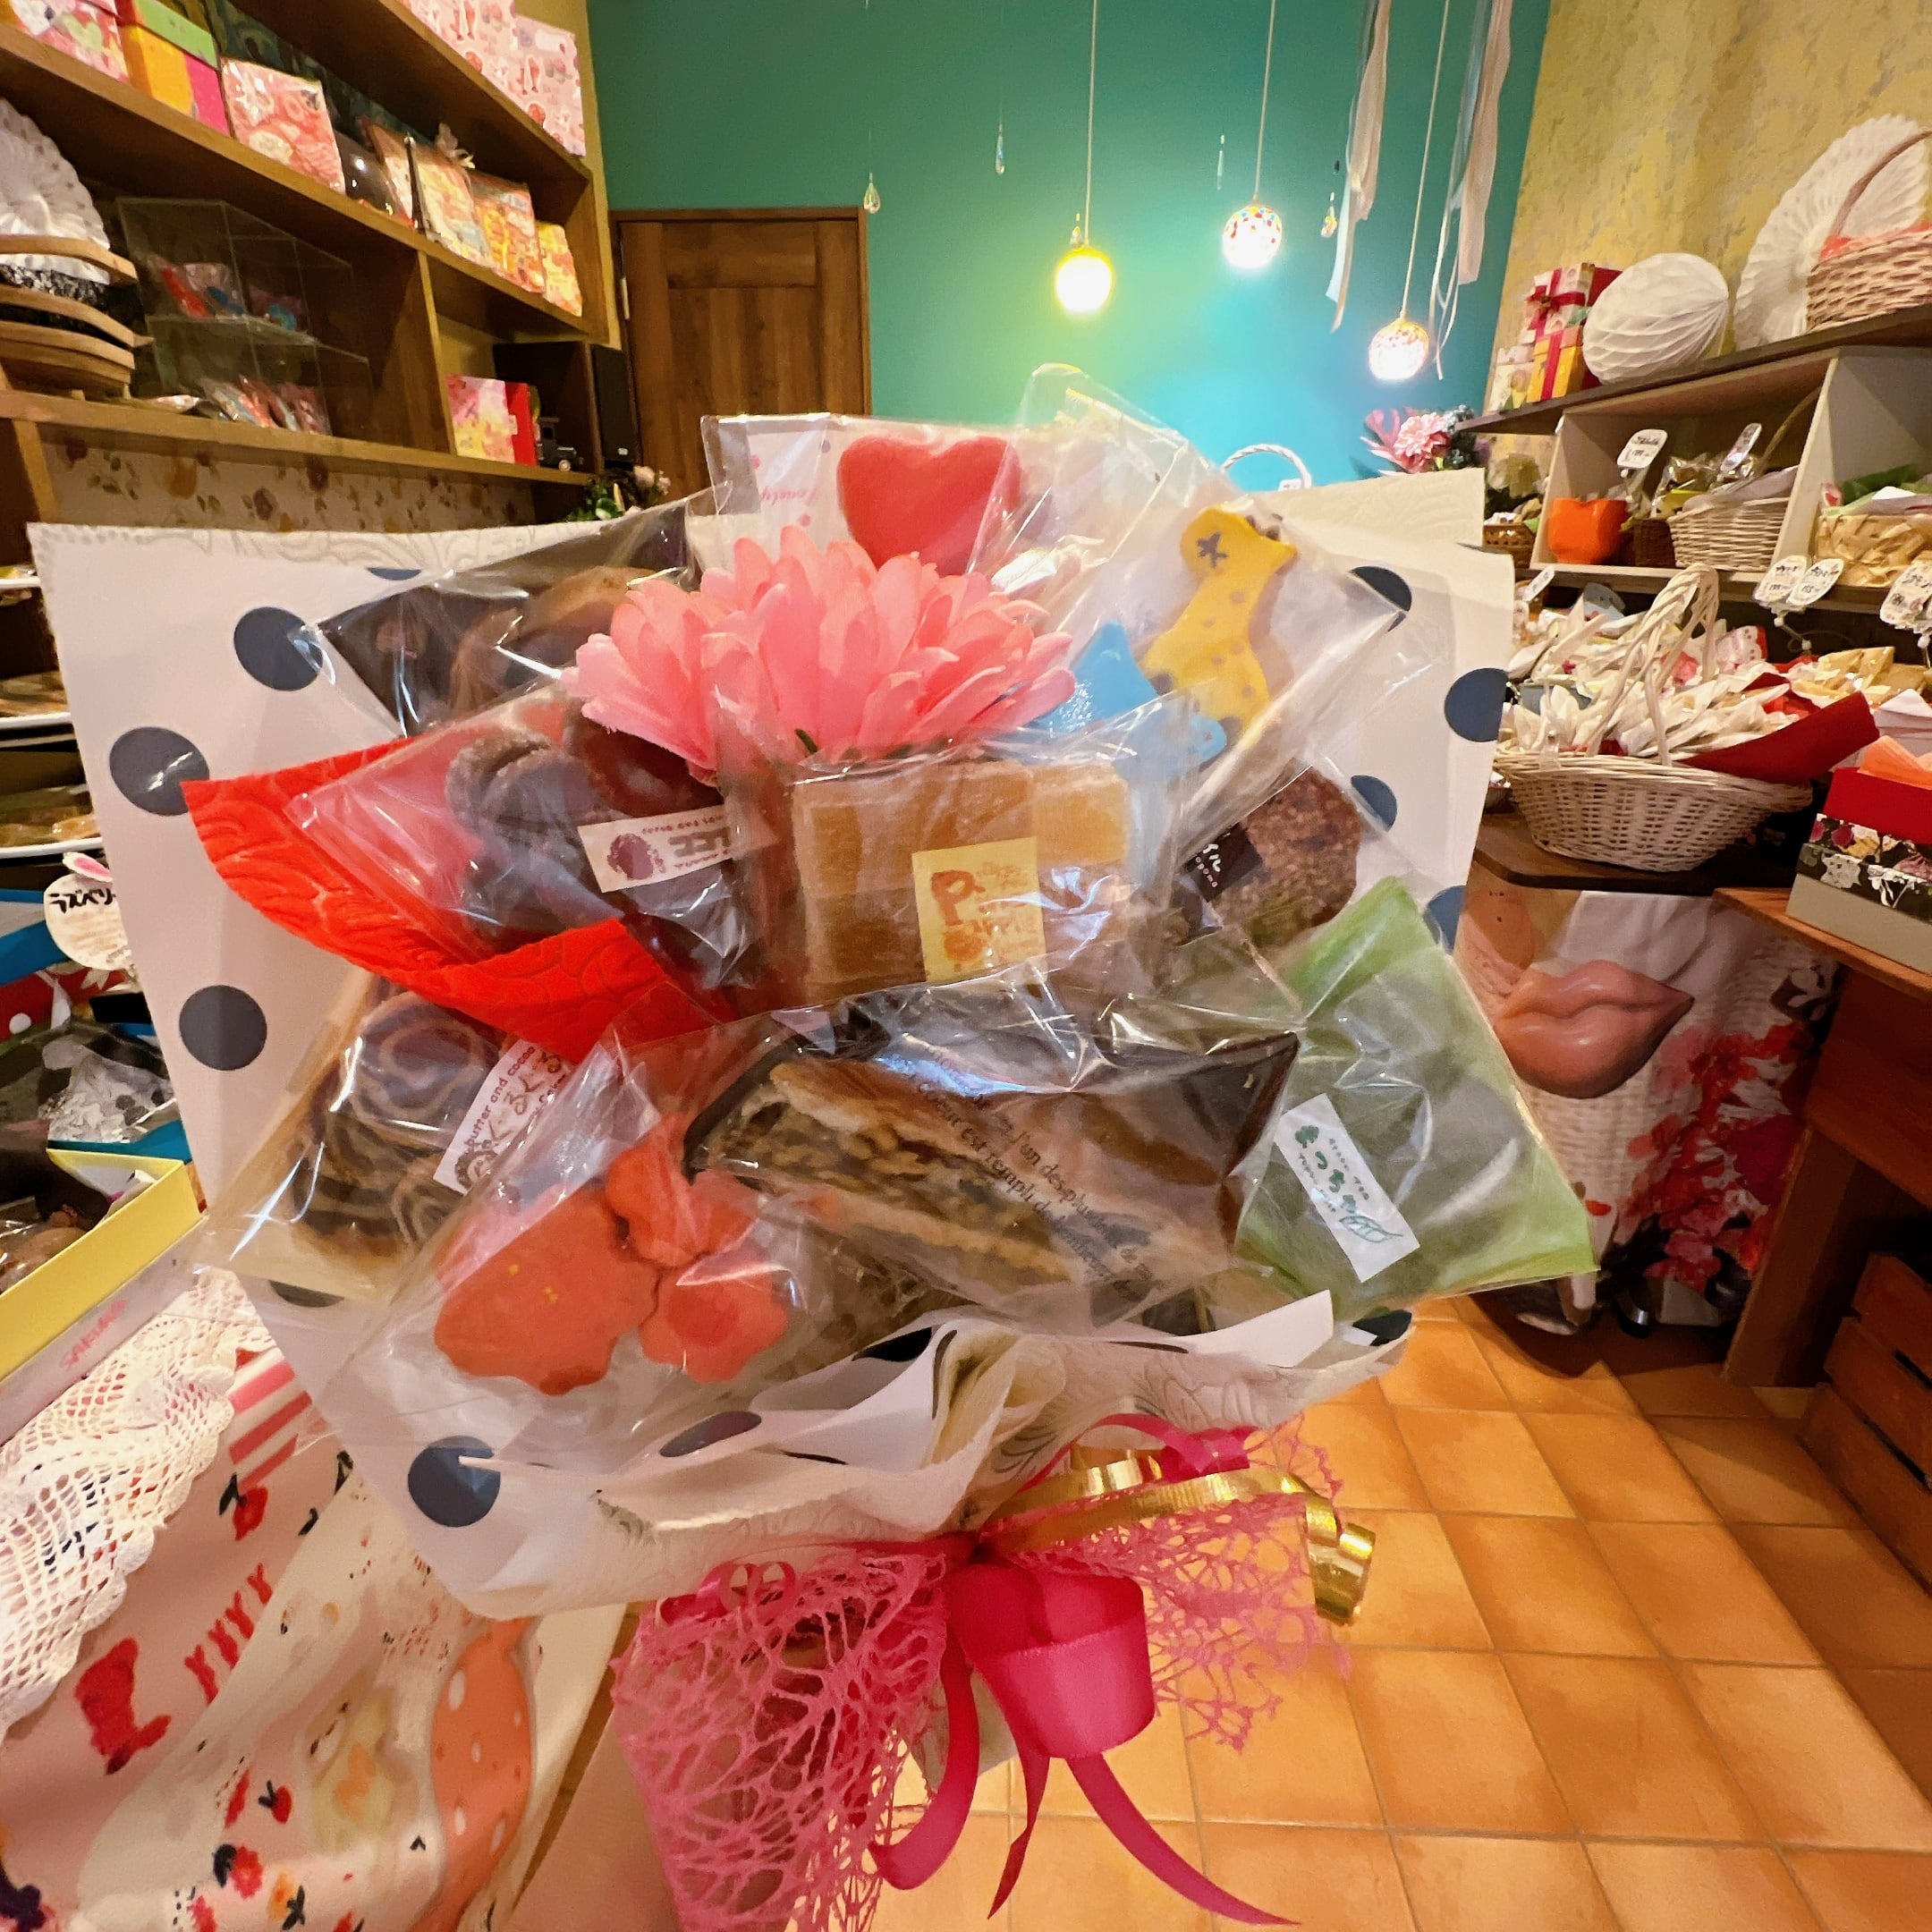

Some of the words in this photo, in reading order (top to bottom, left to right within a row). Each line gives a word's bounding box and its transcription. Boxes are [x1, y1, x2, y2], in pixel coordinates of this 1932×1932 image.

[49, 887, 116, 914] ラズベリ
[464, 1105, 491, 1147] butter
[490, 1077, 508, 1103] and
[507, 1046, 535, 1076] cocoa
